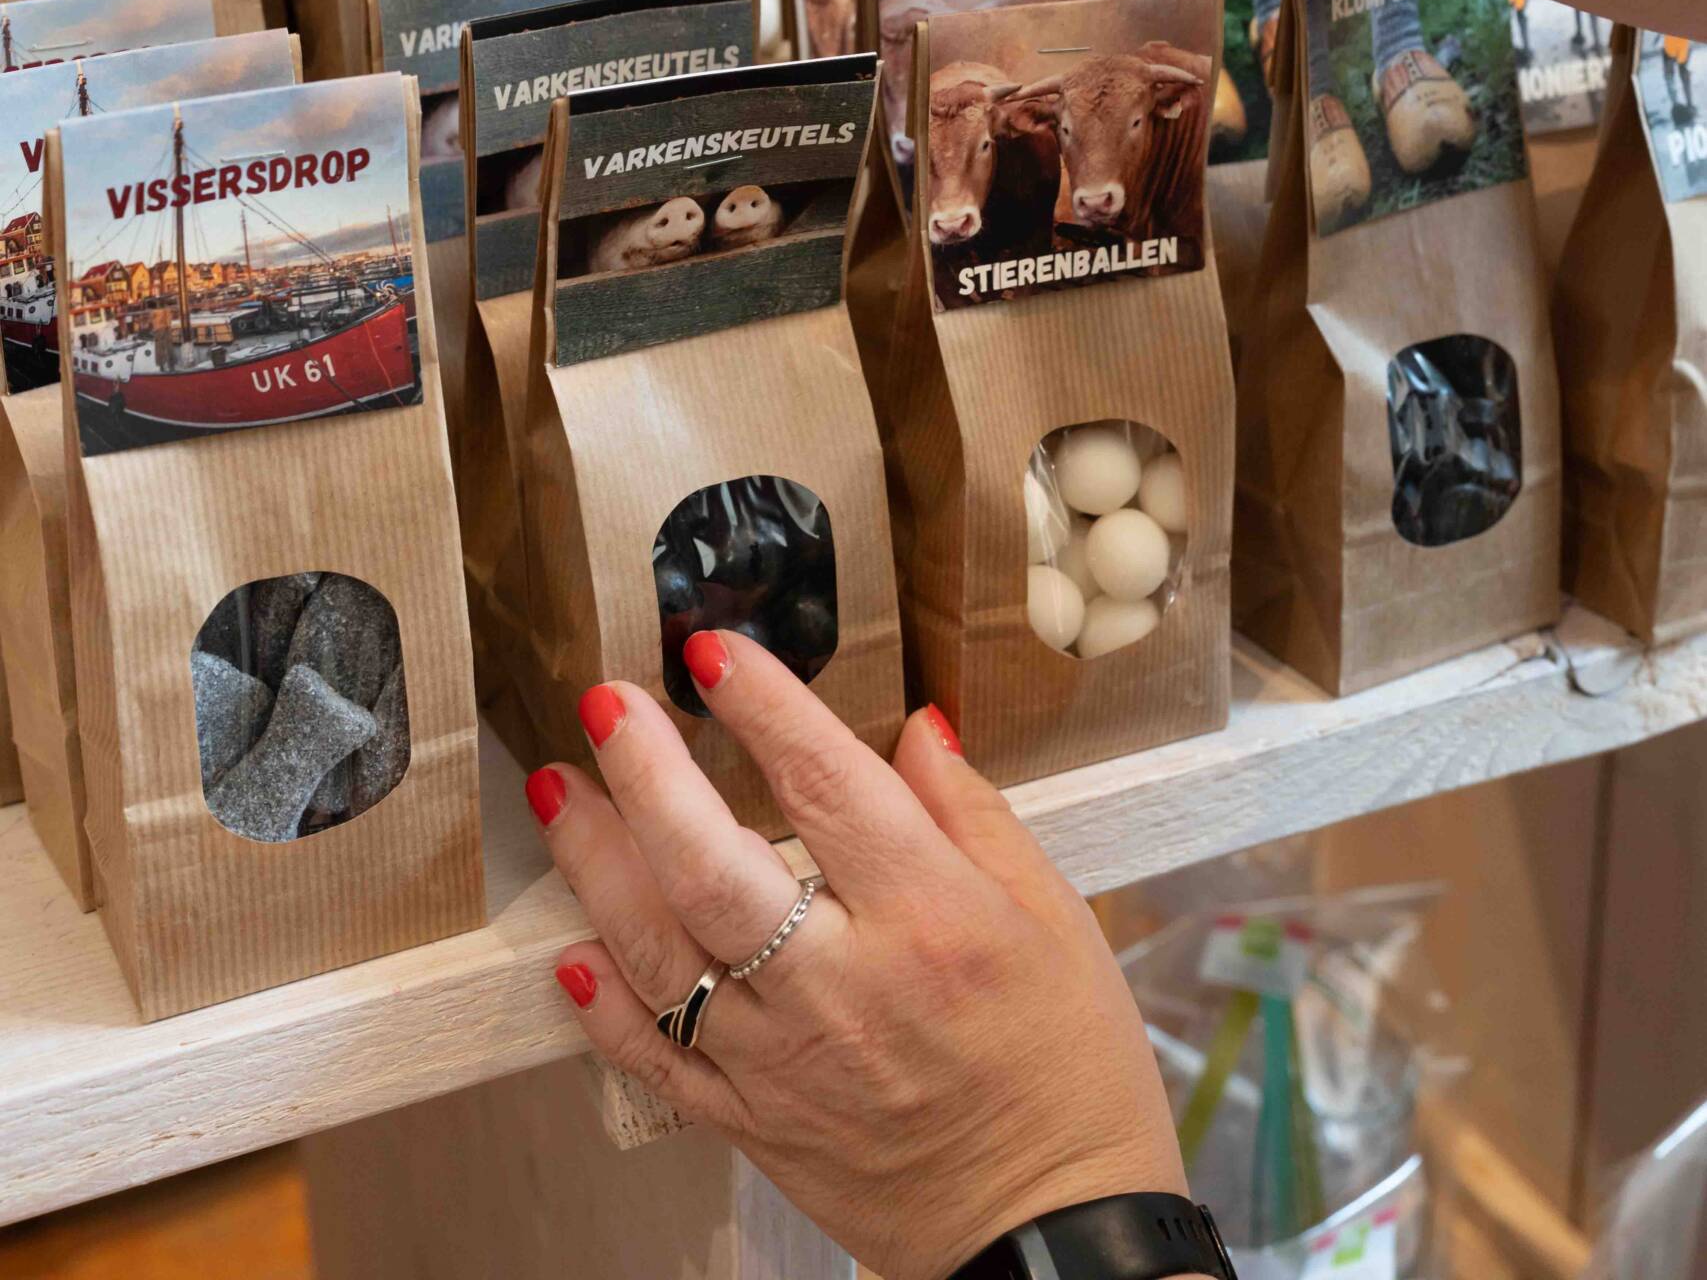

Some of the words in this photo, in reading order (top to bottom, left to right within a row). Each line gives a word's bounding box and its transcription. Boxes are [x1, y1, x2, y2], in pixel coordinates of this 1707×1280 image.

[493, 45, 740, 111] VARKENSKEUTELS
[583, 122, 856, 180] VARKENSKEUTELS
[106, 147, 371, 220] VISSERSDROP
[958, 236, 1179, 296] STIERENBALLEN
[251, 366, 297, 393] UK
[304, 353, 337, 383] 61
